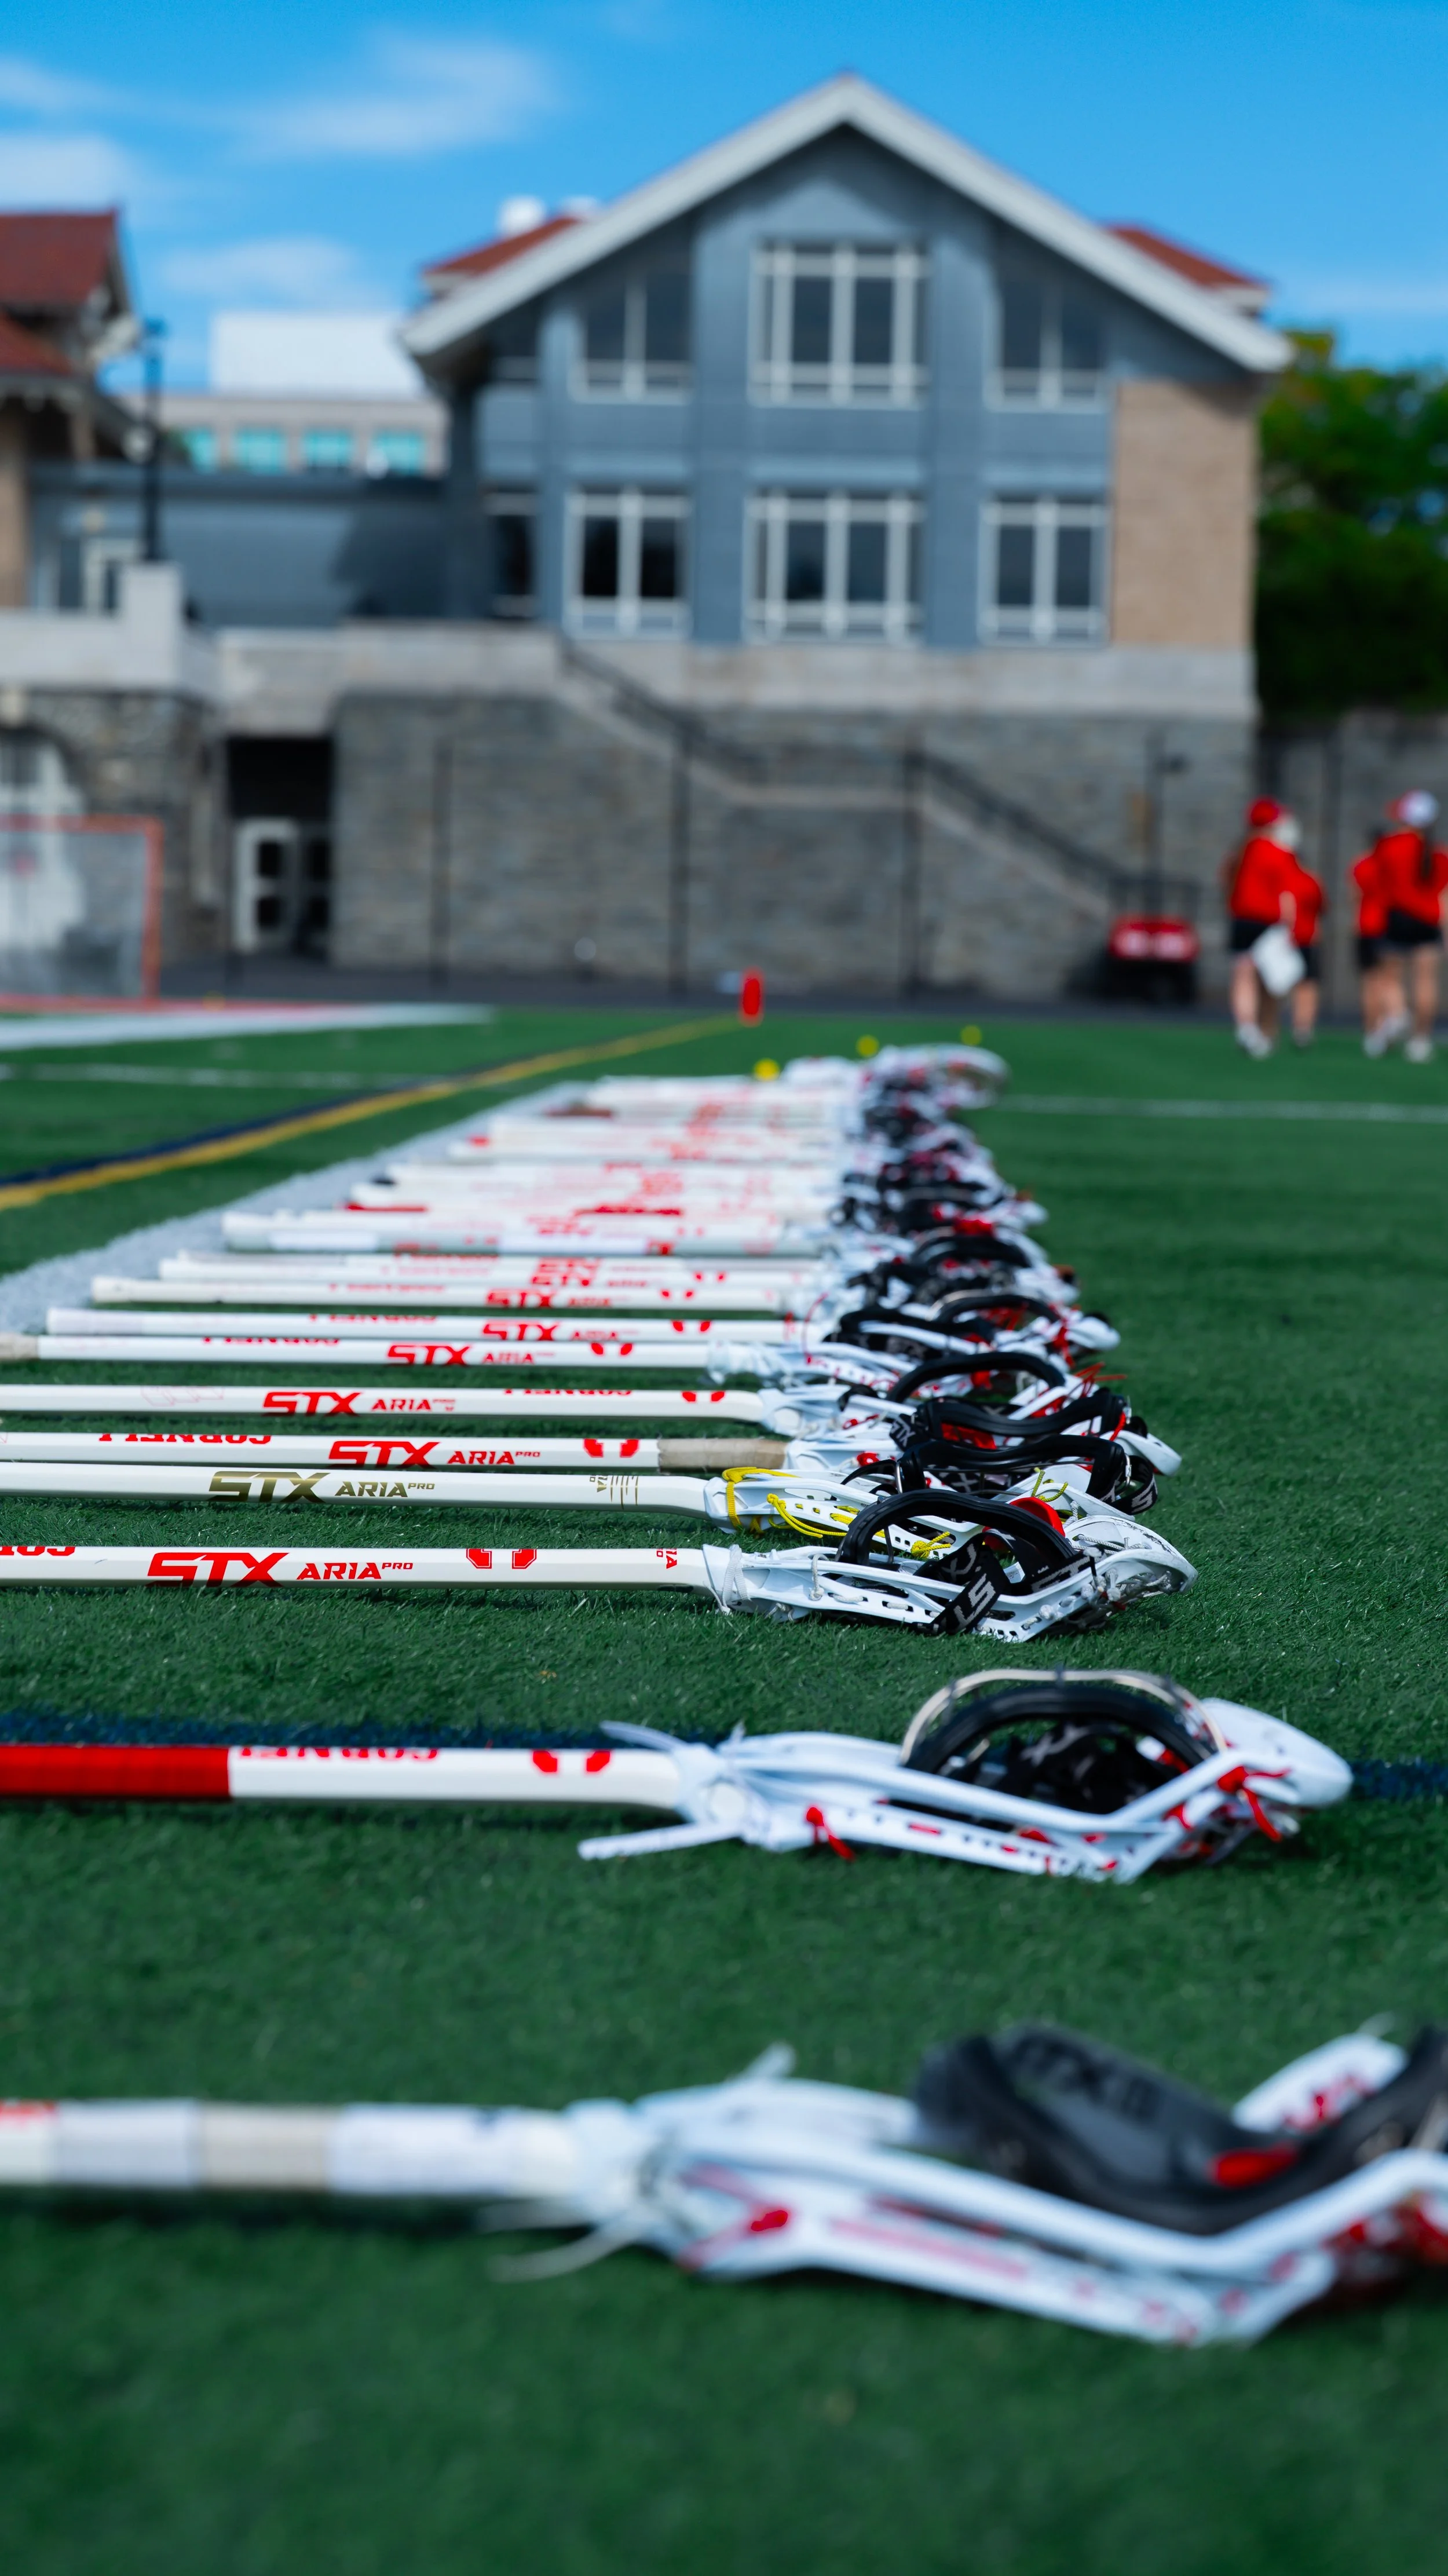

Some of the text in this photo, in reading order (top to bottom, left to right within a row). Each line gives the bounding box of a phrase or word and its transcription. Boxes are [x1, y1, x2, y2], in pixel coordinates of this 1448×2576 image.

[385, 1343, 472, 1366] STX
[261, 1391, 363, 1416] STX
[371, 1398, 432, 1412] ARIA
[326, 1441, 441, 1469] STX
[447, 1450, 515, 1465] ARIA
[206, 1471, 331, 1503] STX
[334, 1482, 408, 1498] ARIA
[145, 1552, 414, 1588] STX ARIA PRO
